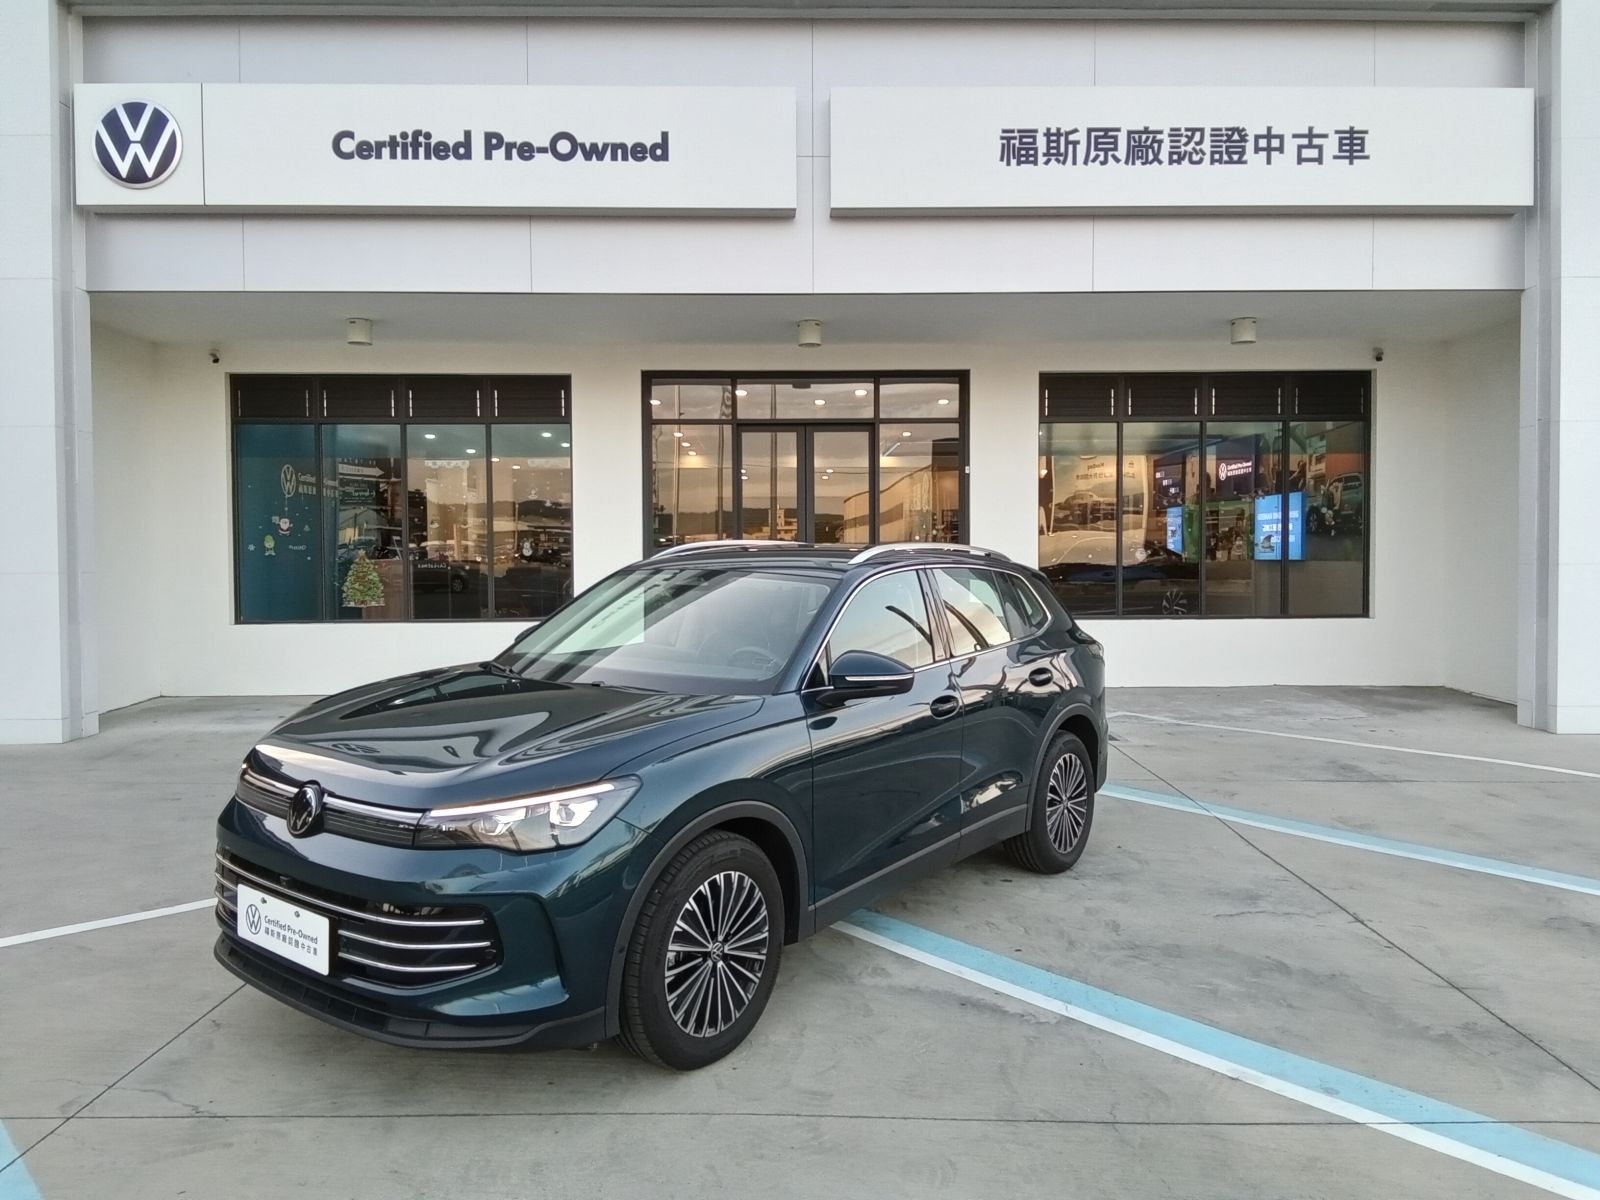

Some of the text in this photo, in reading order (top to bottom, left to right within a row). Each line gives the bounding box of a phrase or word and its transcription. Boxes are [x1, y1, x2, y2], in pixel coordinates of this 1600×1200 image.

[332, 129, 670, 162] Certified Pre-Owned
[999, 126, 1371, 166] 福斯原廠認證中古車
[264, 915, 319, 945] Certified Pre-Owned
